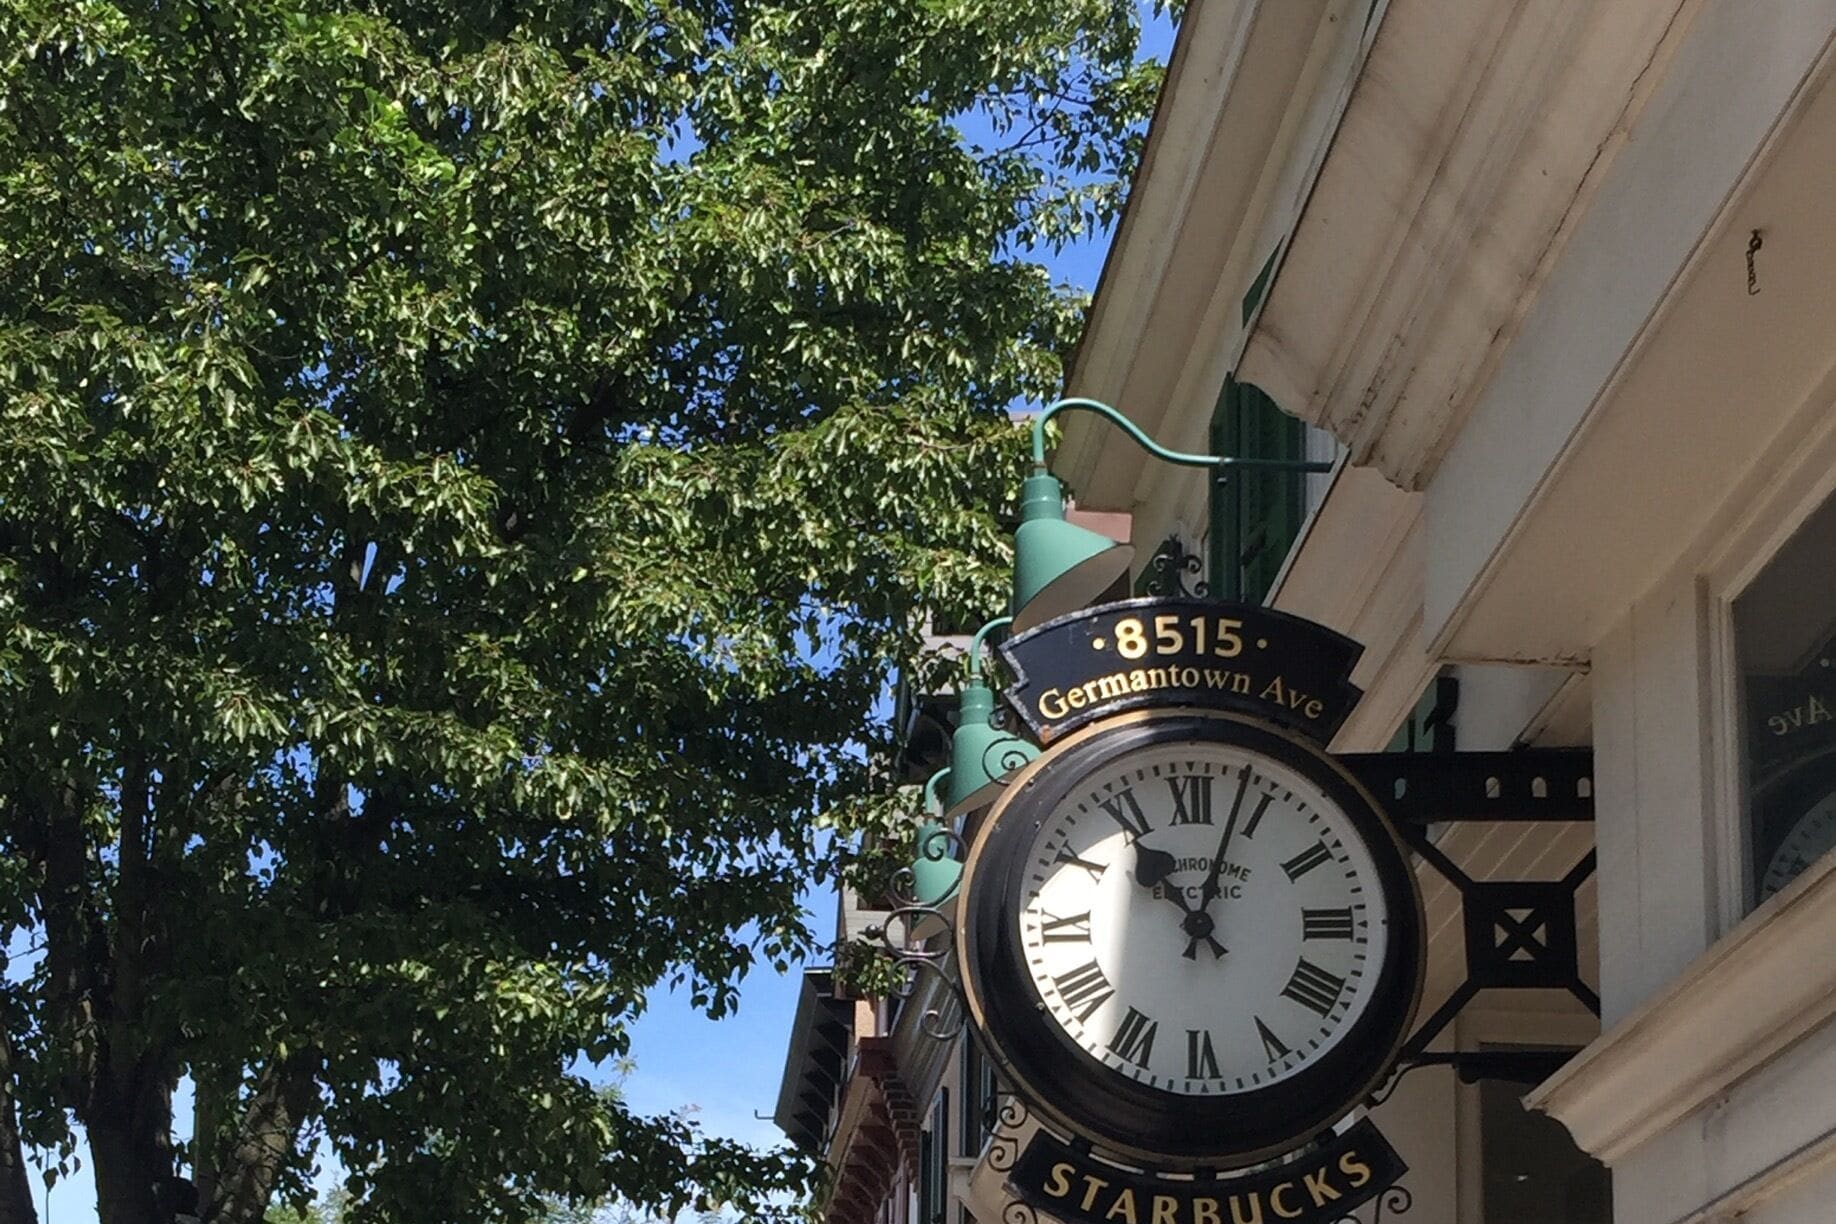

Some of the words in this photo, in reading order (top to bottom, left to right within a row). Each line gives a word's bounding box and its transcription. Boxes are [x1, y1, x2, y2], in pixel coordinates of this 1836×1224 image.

[1114, 615, 1244, 659] 8515
[1038, 663, 1251, 720] Germantown
[1260, 675, 1324, 720] Ave
